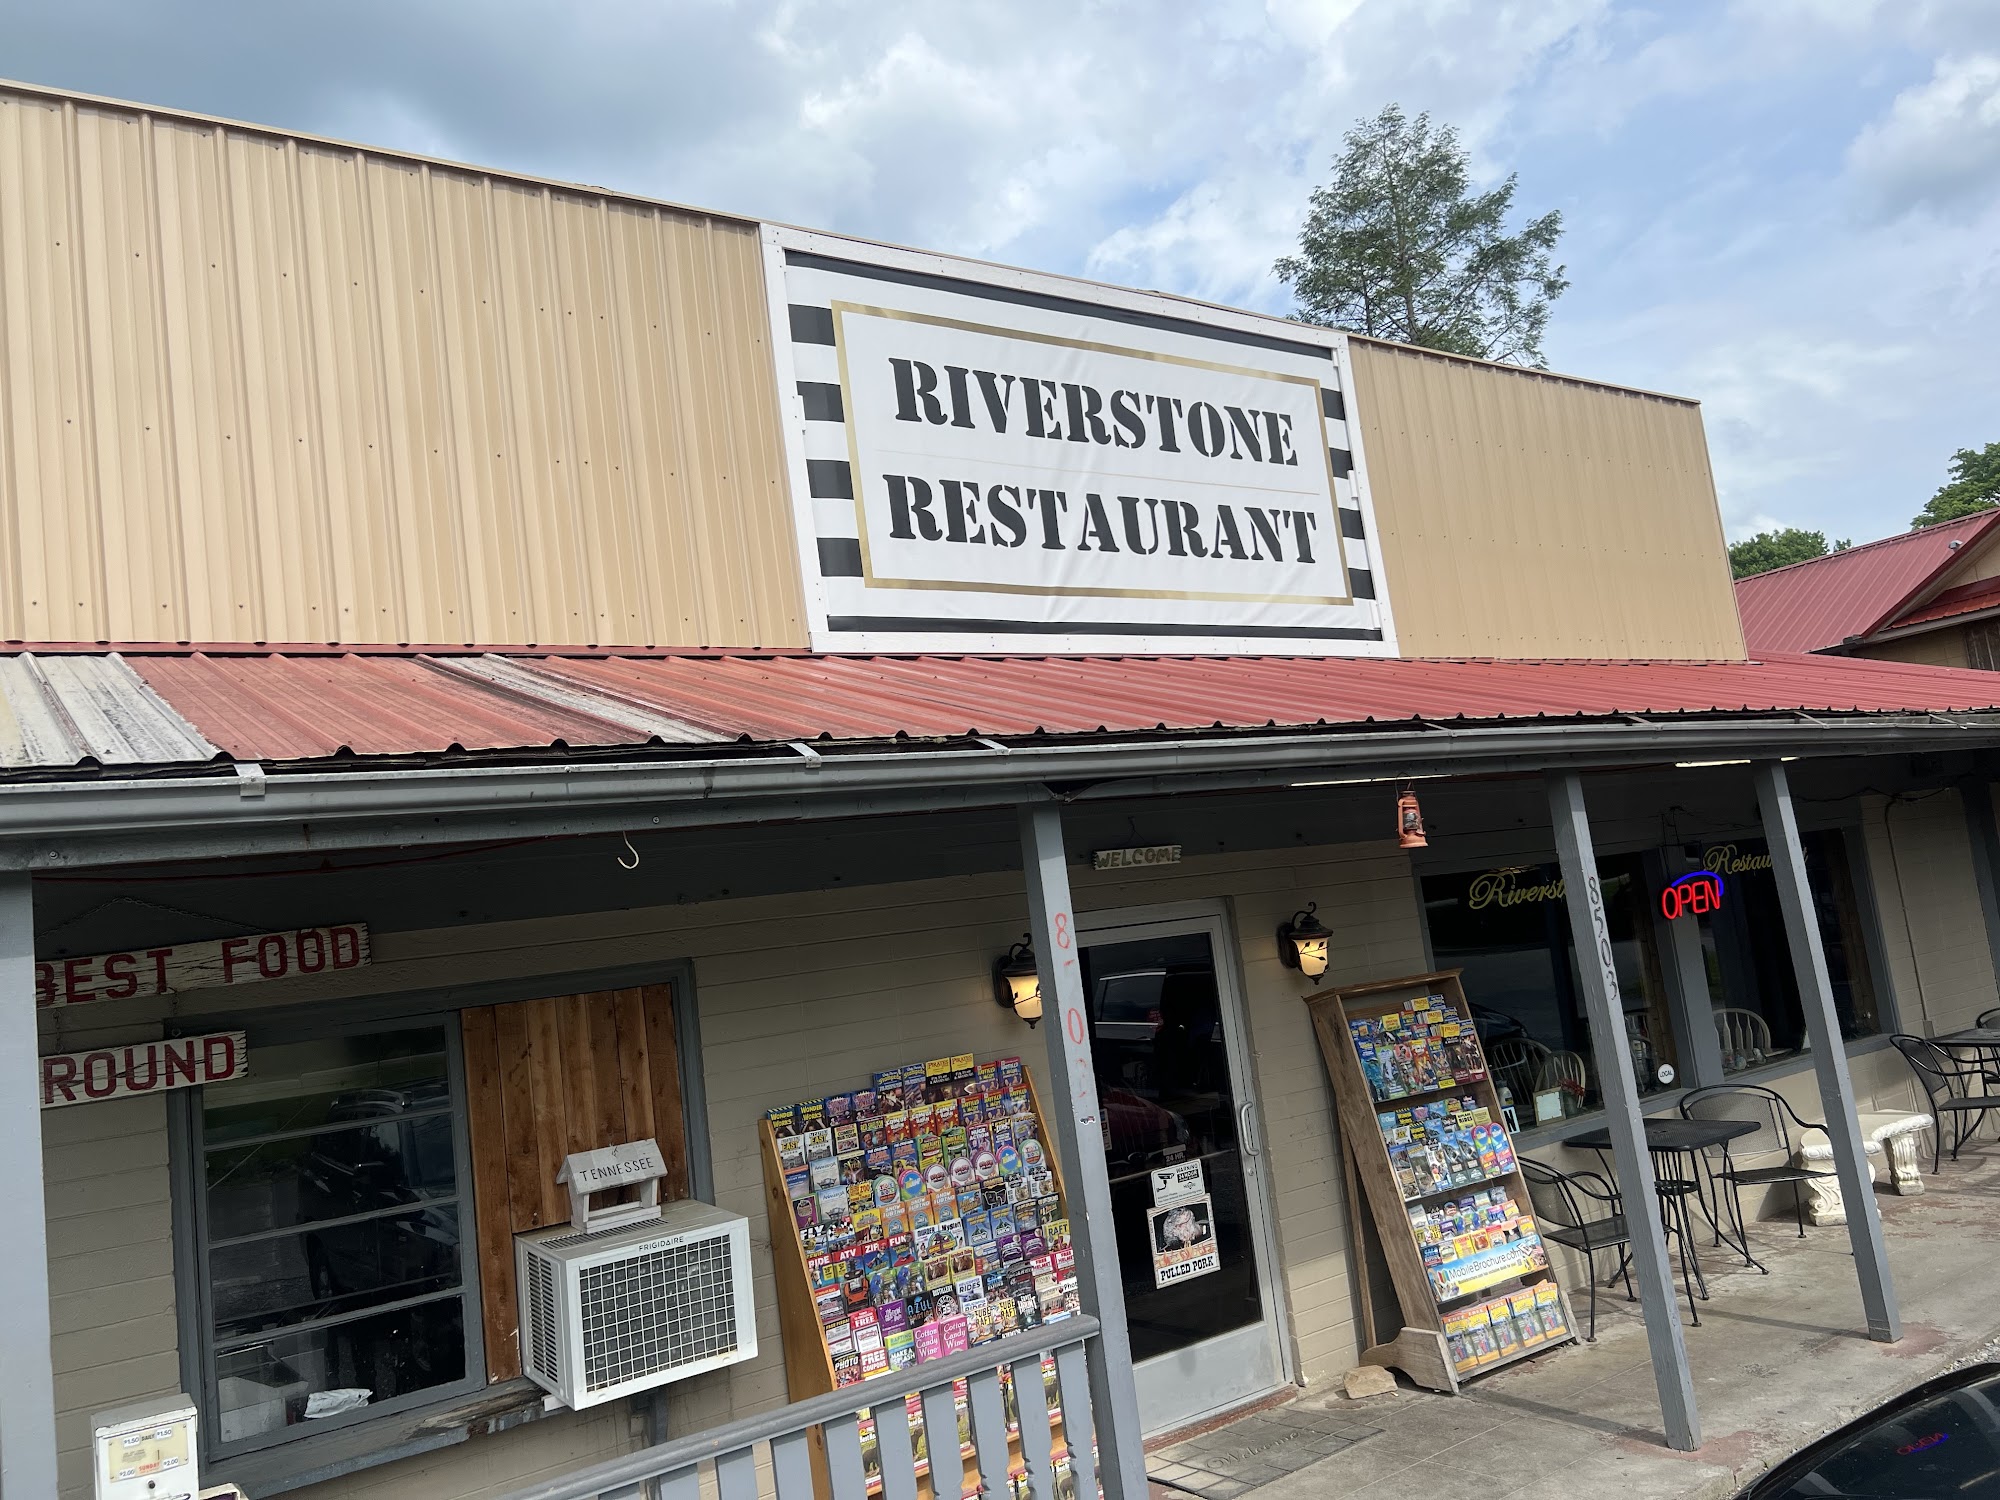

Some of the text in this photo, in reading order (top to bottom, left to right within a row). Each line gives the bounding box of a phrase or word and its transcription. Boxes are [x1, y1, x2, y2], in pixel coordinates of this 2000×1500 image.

[888, 358, 1298, 466] RIVERSTONE
[883, 474, 1317, 564] RESTAURANT
[1096, 847, 1181, 868] WELCOME
[1662, 880, 1720, 919] OPEN
[35, 926, 361, 1007] BEST FOOD
[43, 1035, 235, 1105] ROUND
[1660, 1070, 1673, 1078] LOCAL
[801, 1105, 823, 1113] WONDER
[770, 1111, 793, 1120] WONDER
[803, 1112, 822, 1121] WORKS
[773, 1119, 792, 1128] WORKS
[781, 1142, 799, 1151] EAST
[580, 1157, 654, 1181] TENNESSEE
[800, 1225, 824, 1240] FLY
[1048, 1223, 1068, 1236] RAFT
[639, 1236, 684, 1251] FRIGIDAIRE
[889, 1235, 906, 1246] FUN
[840, 1249, 857, 1260] ATV
[808, 1256, 830, 1268] RIDE
[1161, 1256, 1213, 1281] PULLED PORK
[959, 1282, 980, 1293] RIDES
[908, 1299, 932, 1315] AZUL
[855, 1316, 875, 1328] FREE
[944, 1322, 966, 1333] Cotton
[915, 1327, 937, 1339] Cotton
[944, 1329, 966, 1341] Candy
[916, 1338, 938, 1349] Candy
[946, 1339, 965, 1349] Wine
[861, 1350, 886, 1366] FREE
[891, 1350, 906, 1359] MAKE
[894, 1353, 916, 1363] SPLASH
[919, 1348, 937, 1357] Wine
[834, 1356, 858, 1371] PHOTO
[863, 1361, 886, 1372] COUPONS
[119, 1469, 135, 1477] $2.00
[139, 1462, 160, 1471] SUNDAY
